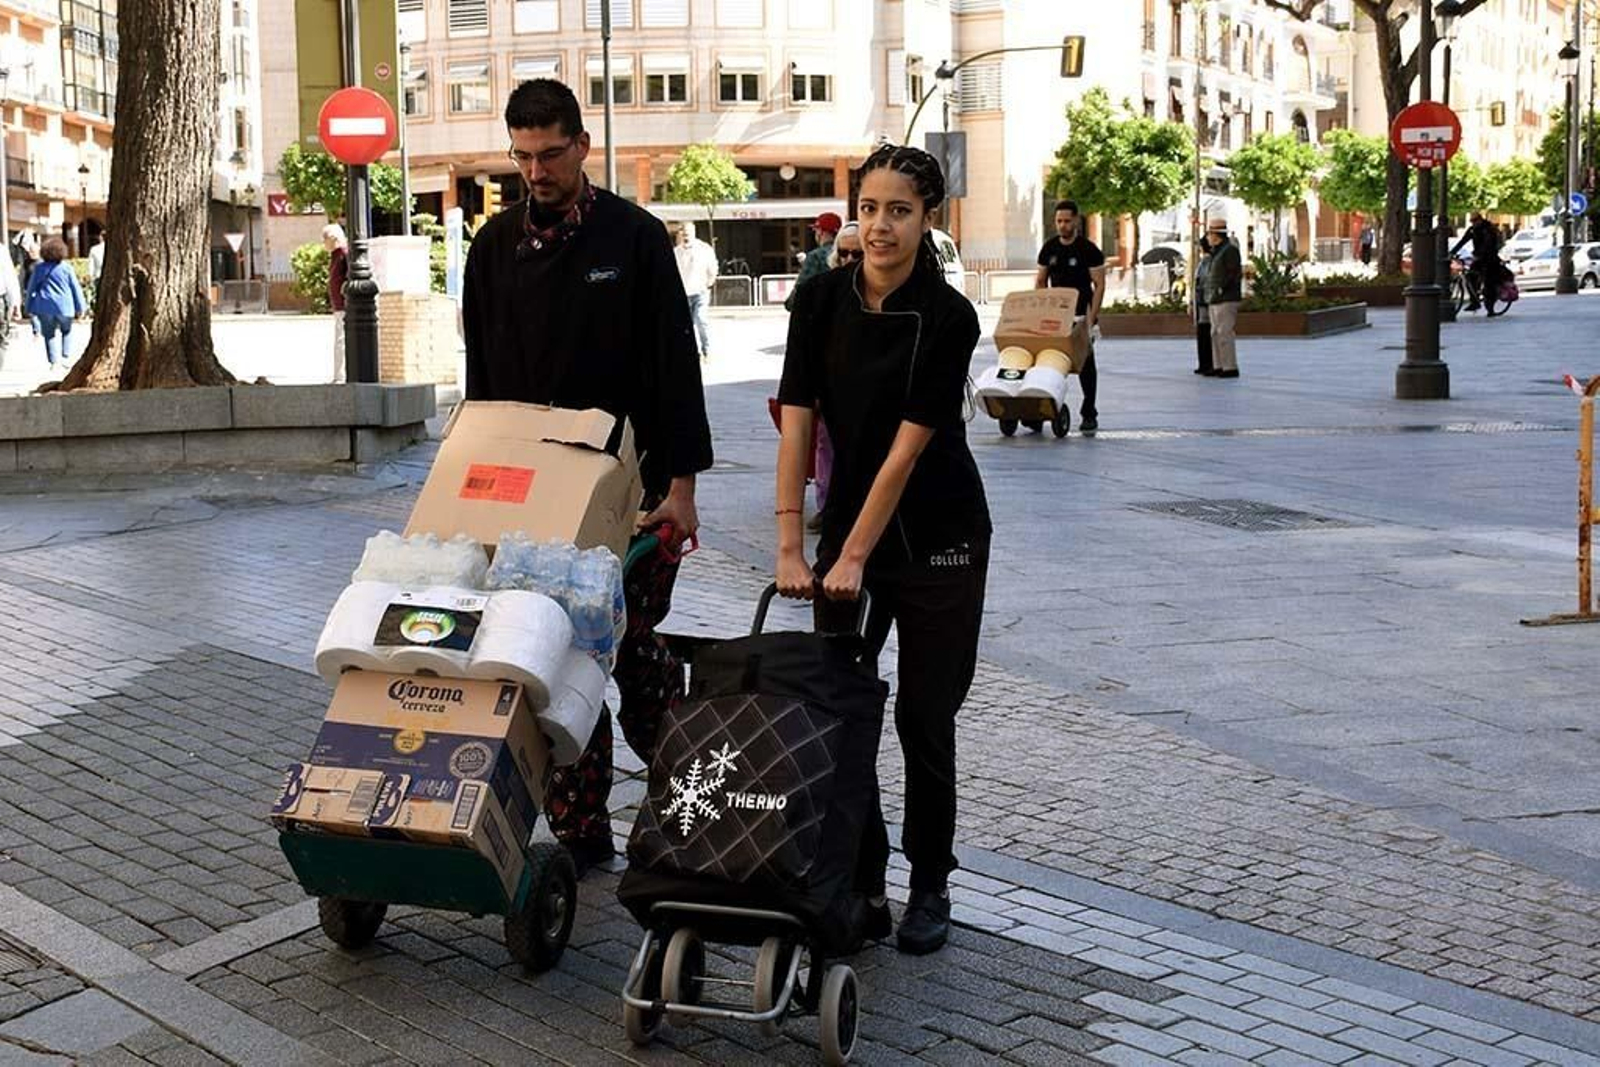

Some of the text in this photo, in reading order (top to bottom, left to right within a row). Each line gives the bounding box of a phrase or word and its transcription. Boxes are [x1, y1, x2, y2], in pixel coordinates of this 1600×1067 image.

[930, 554, 971, 566] COLLEGE
[388, 679, 464, 702] Corona
[401, 701, 446, 713] cerveza
[725, 791, 787, 809] THERMO
